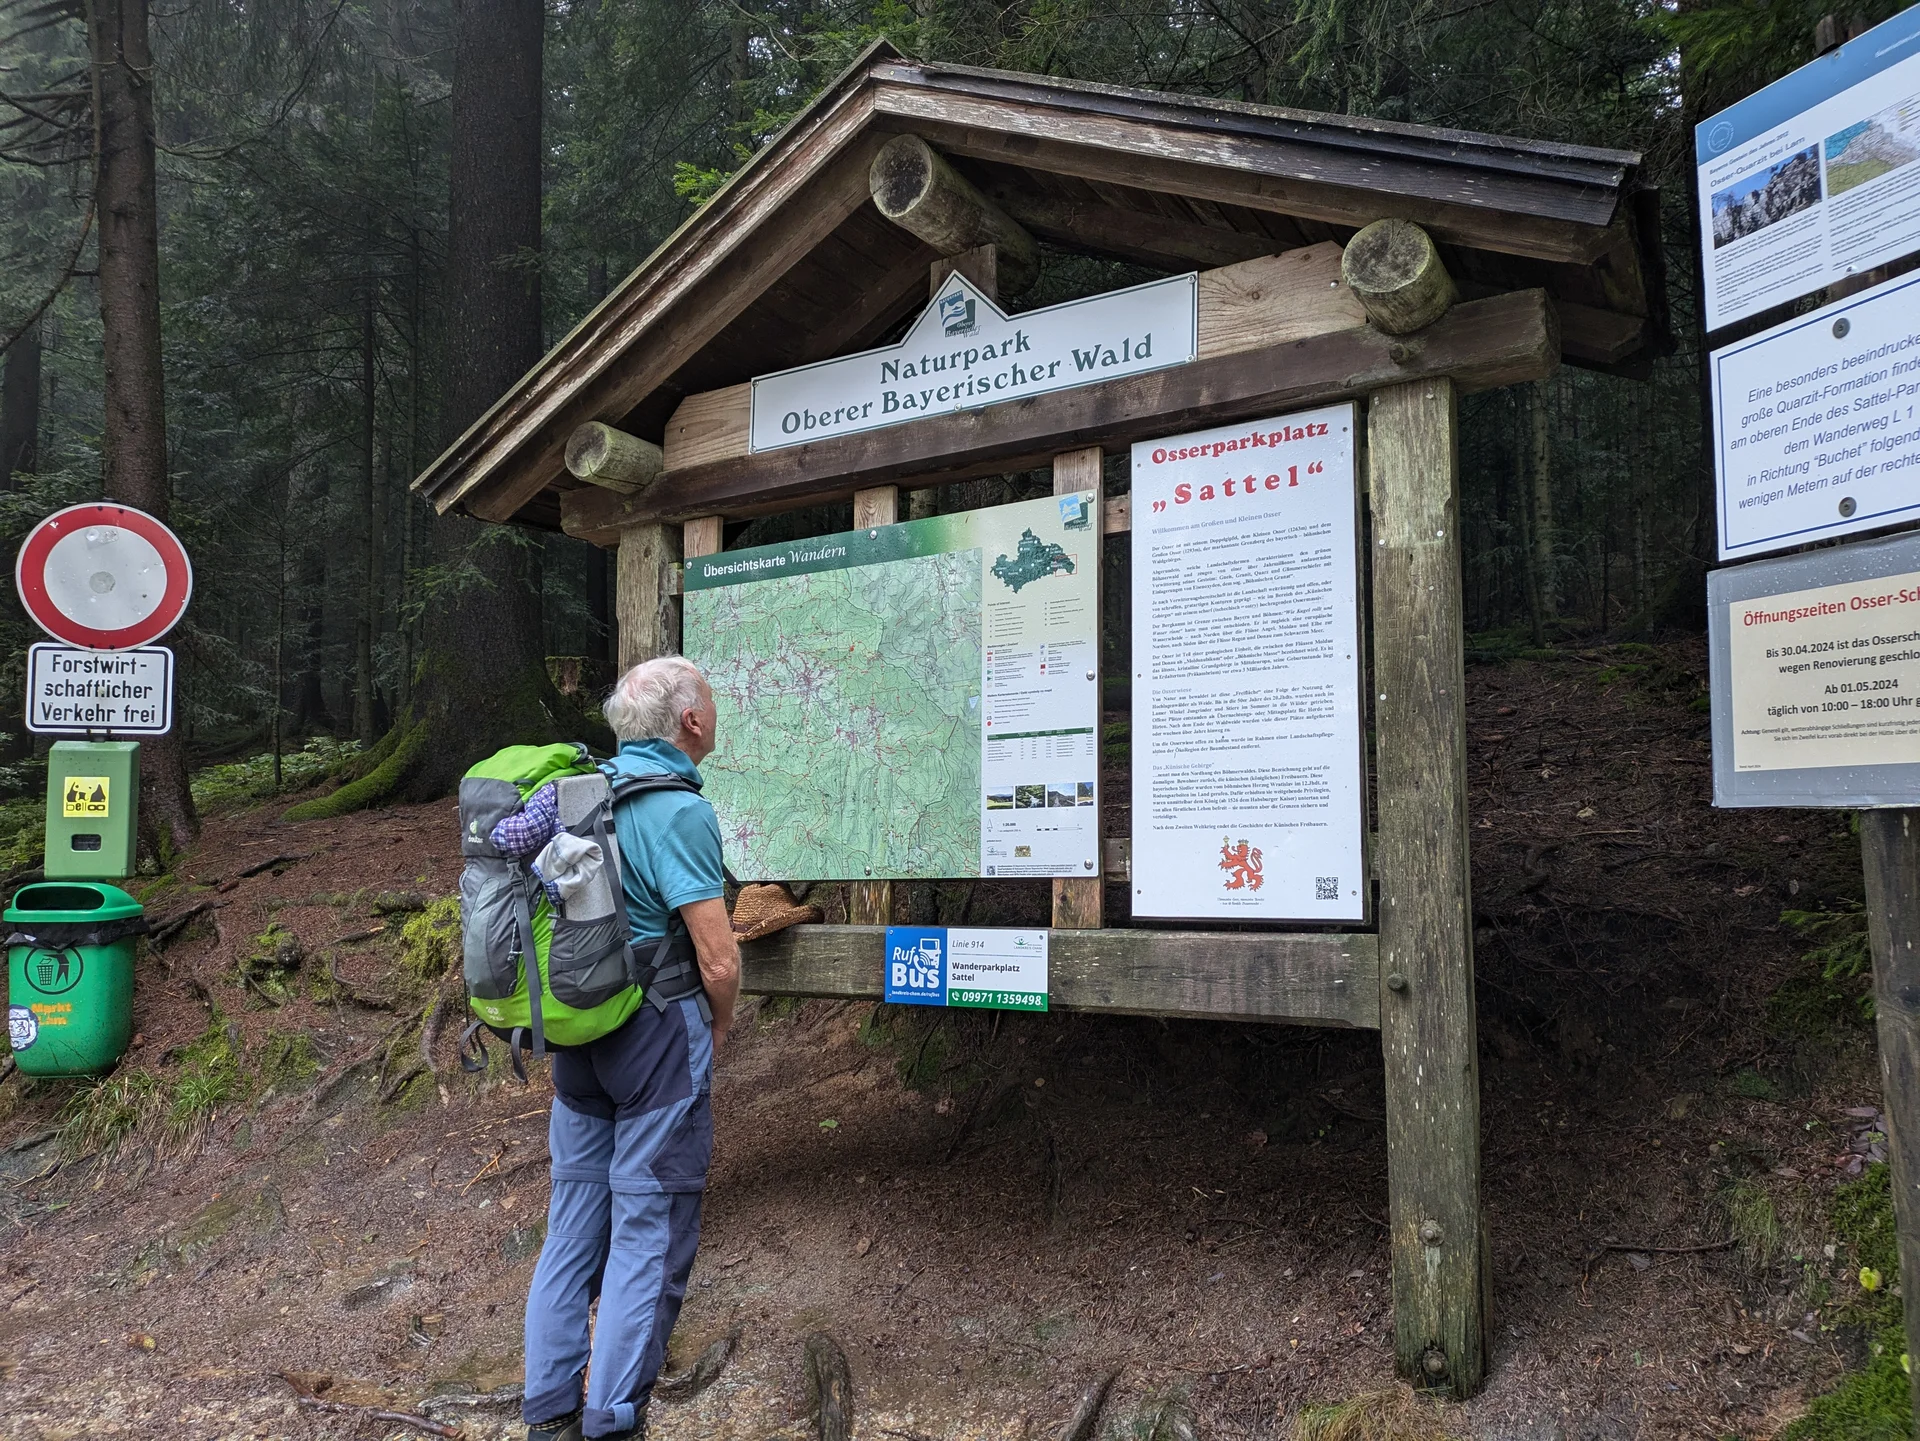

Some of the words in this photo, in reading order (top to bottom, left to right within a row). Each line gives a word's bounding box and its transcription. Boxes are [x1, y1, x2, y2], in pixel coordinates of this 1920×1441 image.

[1711, 155, 1767, 187] Osser-Quarzit
[1770, 147, 1783, 158] bei
[880, 329, 1032, 384] Naturpark
[782, 398, 873, 434] Oberer
[882, 357, 1062, 415] Bayerischer
[1071, 333, 1153, 372] Wald
[1748, 387, 1773, 403] Eine
[1776, 363, 1838, 393] besonders
[1741, 407, 1773, 428] große
[1777, 369, 1888, 414] Quarzit-Formation
[1730, 437, 1747, 450] am
[1750, 424, 1788, 444] oberen
[1792, 412, 1823, 431] Ende
[1826, 405, 1849, 420] des
[1784, 439, 1809, 455] dem
[1813, 416, 1889, 446] Wanderweg
[1892, 410, 1901, 423] L
[1906, 405, 1914, 419] 1
[1152, 422, 1328, 464] Osserparkplatz
[1747, 474, 1757, 487] in
[1760, 461, 1810, 483] Richtung
[1739, 490, 1784, 509] wenigen
[1787, 478, 1828, 497] Metern
[1832, 468, 1853, 485] auf
[1855, 465, 1878, 479] der
[1152, 525, 1190, 534] Willkommen
[1201, 520, 1224, 528] Großen
[704, 556, 786, 578] Übersichtskarte
[788, 545, 846, 564] Wandern
[1744, 602, 1846, 626] Öffnungszeiten
[1766, 648, 1779, 658] Bis
[1781, 641, 1835, 657] 30.04.2024
[1837, 640, 1850, 650] ist
[1851, 638, 1870, 648] das
[53, 654, 147, 674] Forstwirt-
[1778, 663, 1811, 673] wegen
[1813, 656, 1877, 670] Renovierung
[44, 679, 153, 699] schaftlicher
[1824, 684, 1838, 694] Ab
[1840, 679, 1899, 693] 01.05.2024
[41, 702, 116, 722] Verkehr
[124, 705, 156, 723] frei
[1767, 704, 1798, 717] täglich
[1800, 705, 1819, 713] von
[1821, 701, 1849, 712] 10:00
[1860, 697, 1890, 709] 18:00
[1892, 696, 1913, 707] Uhr
[66, 802, 105, 812] belloo
[952, 940, 969, 948] Linie
[971, 940, 984, 948] 914
[893, 946, 916, 965] Ruf
[892, 962, 939, 989] Bus
[952, 962, 1020, 973] Wanderparkplatz
[952, 973, 974, 981] Sattel
[31, 1003, 72, 1013] Markt
[962, 991, 992, 1003] 09971
[997, 994, 1041, 1006] 1359498
